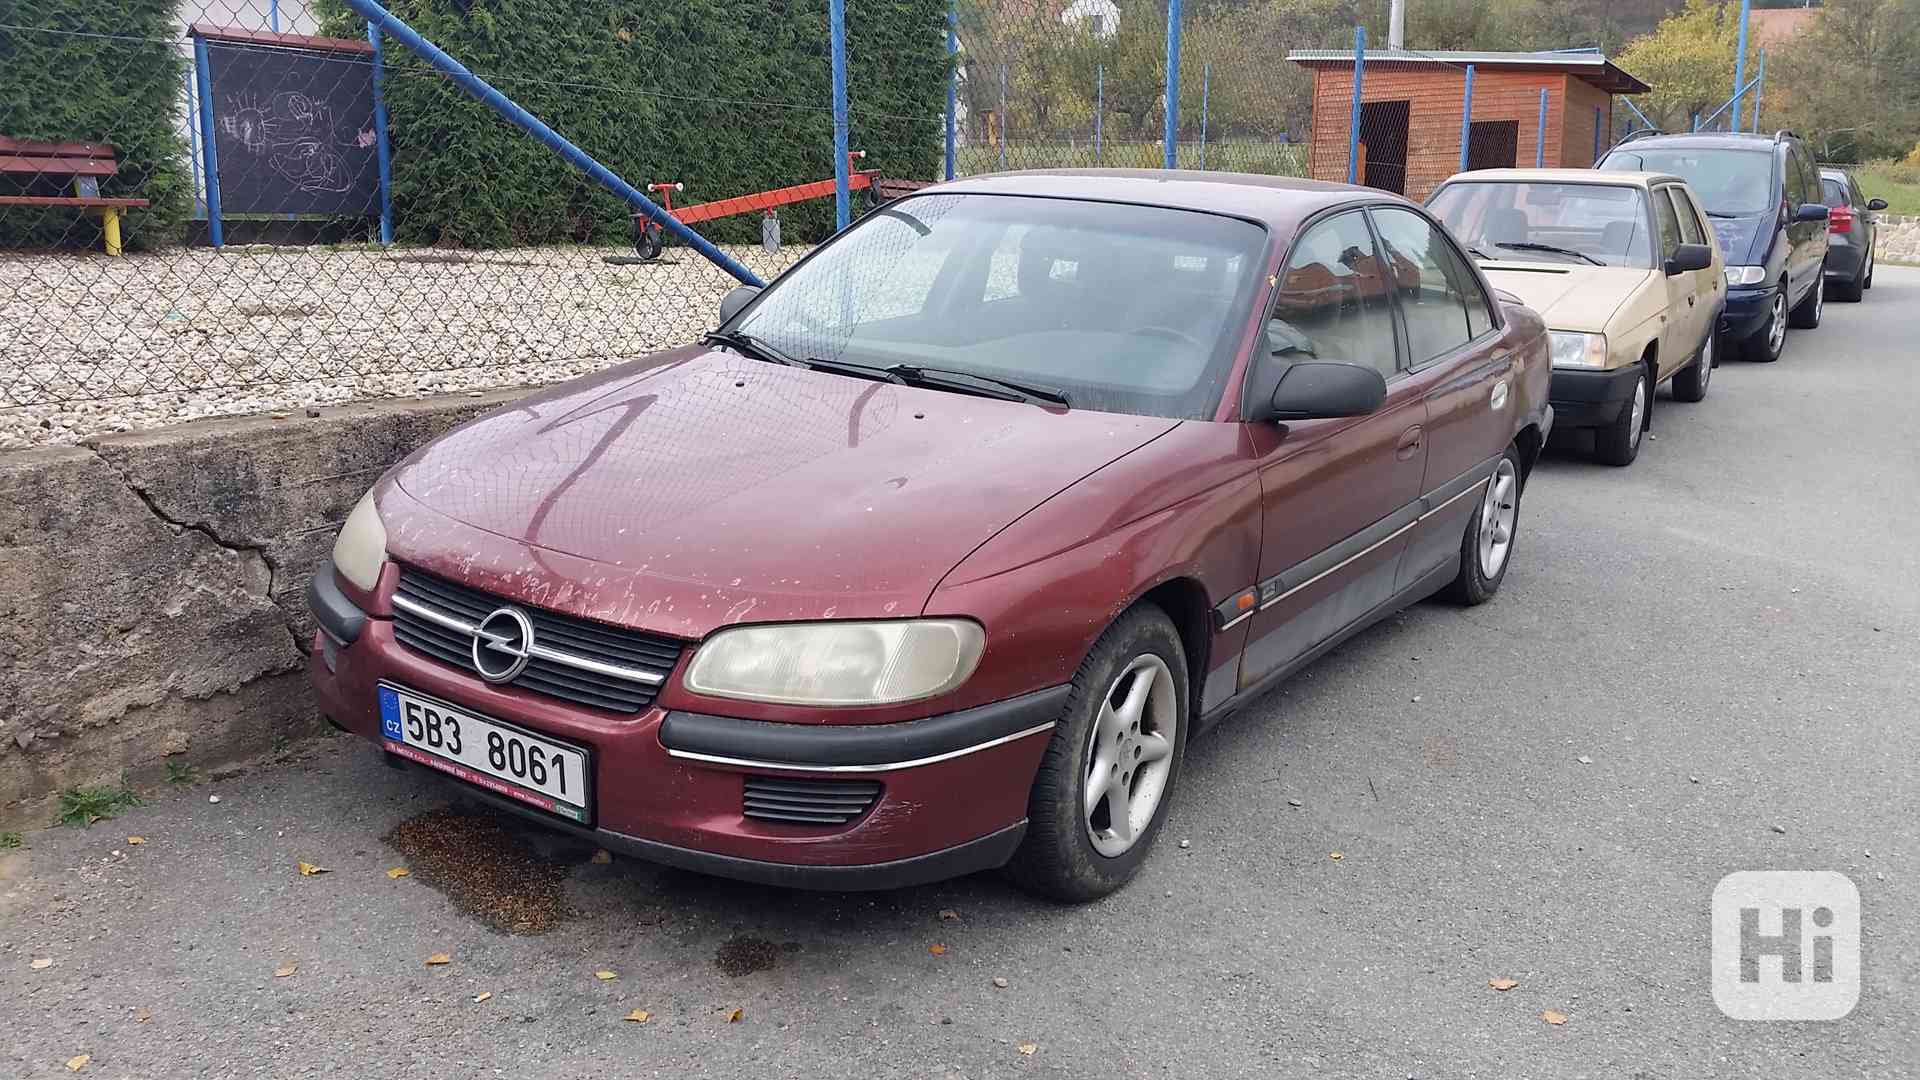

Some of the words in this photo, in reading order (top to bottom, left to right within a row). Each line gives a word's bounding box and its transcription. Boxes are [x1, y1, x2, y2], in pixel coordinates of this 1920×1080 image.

[386, 719, 401, 734] CZ
[405, 701, 462, 756] 5B3
[487, 731, 567, 796] 8061
